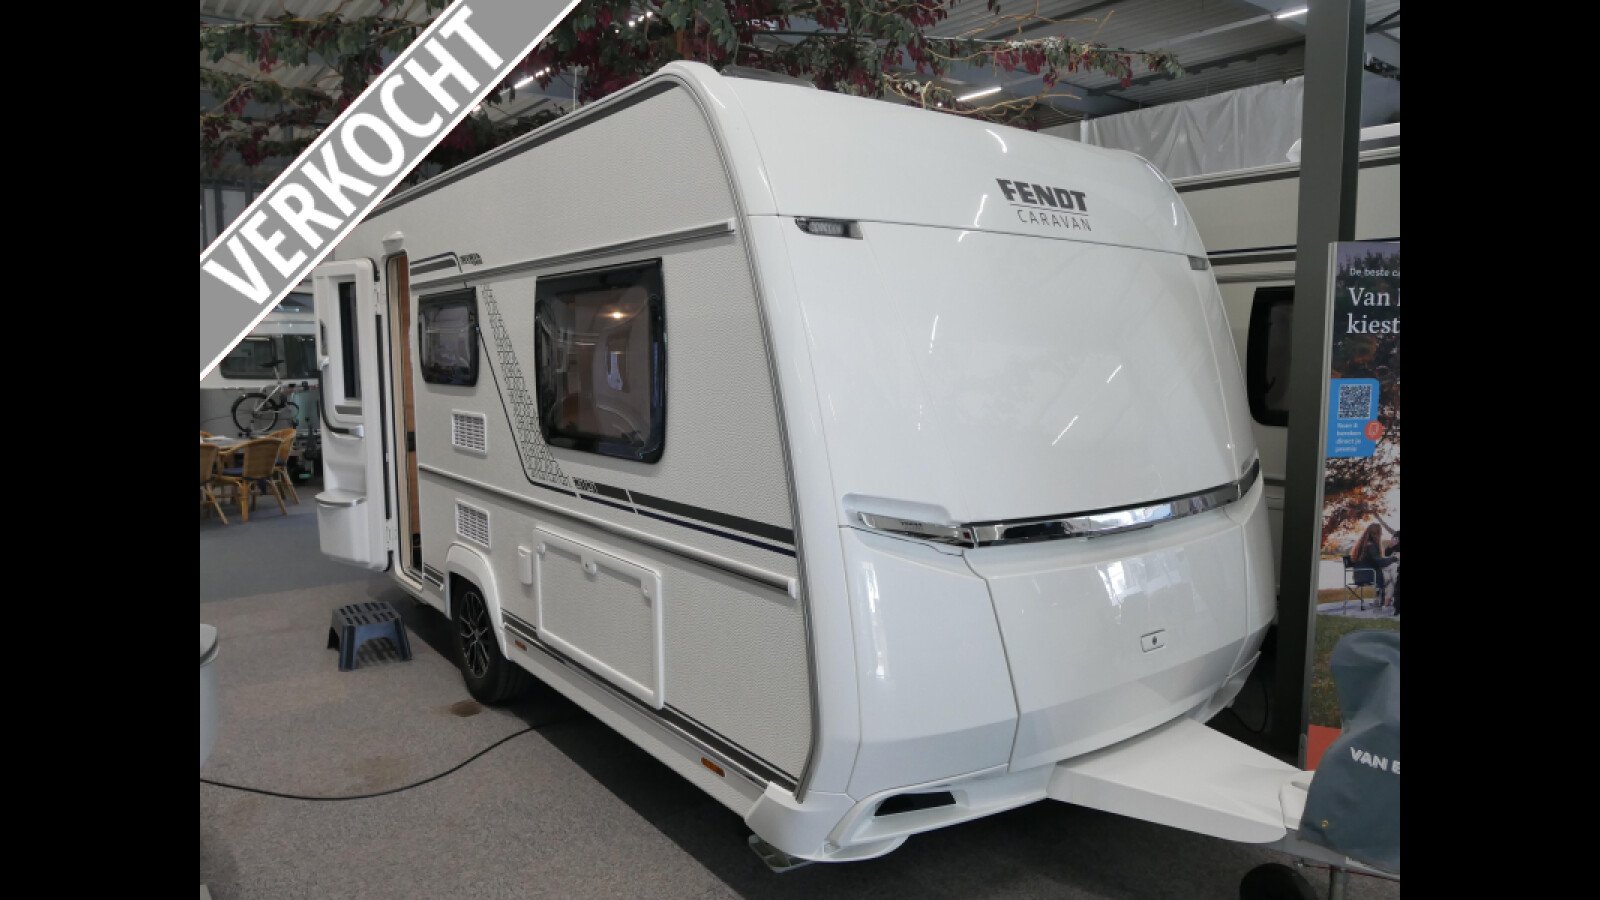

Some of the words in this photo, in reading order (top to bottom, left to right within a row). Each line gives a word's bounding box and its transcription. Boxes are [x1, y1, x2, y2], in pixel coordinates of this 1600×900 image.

[995, 178, 1087, 212] FENDT
[1017, 209, 1092, 232] CARAVAN
[1350, 267, 1361, 276] De
[1364, 267, 1389, 276] beste
[1348, 287, 1391, 306] Van
[1346, 312, 1400, 334] kiest
[1350, 746, 1388, 771] VAN
